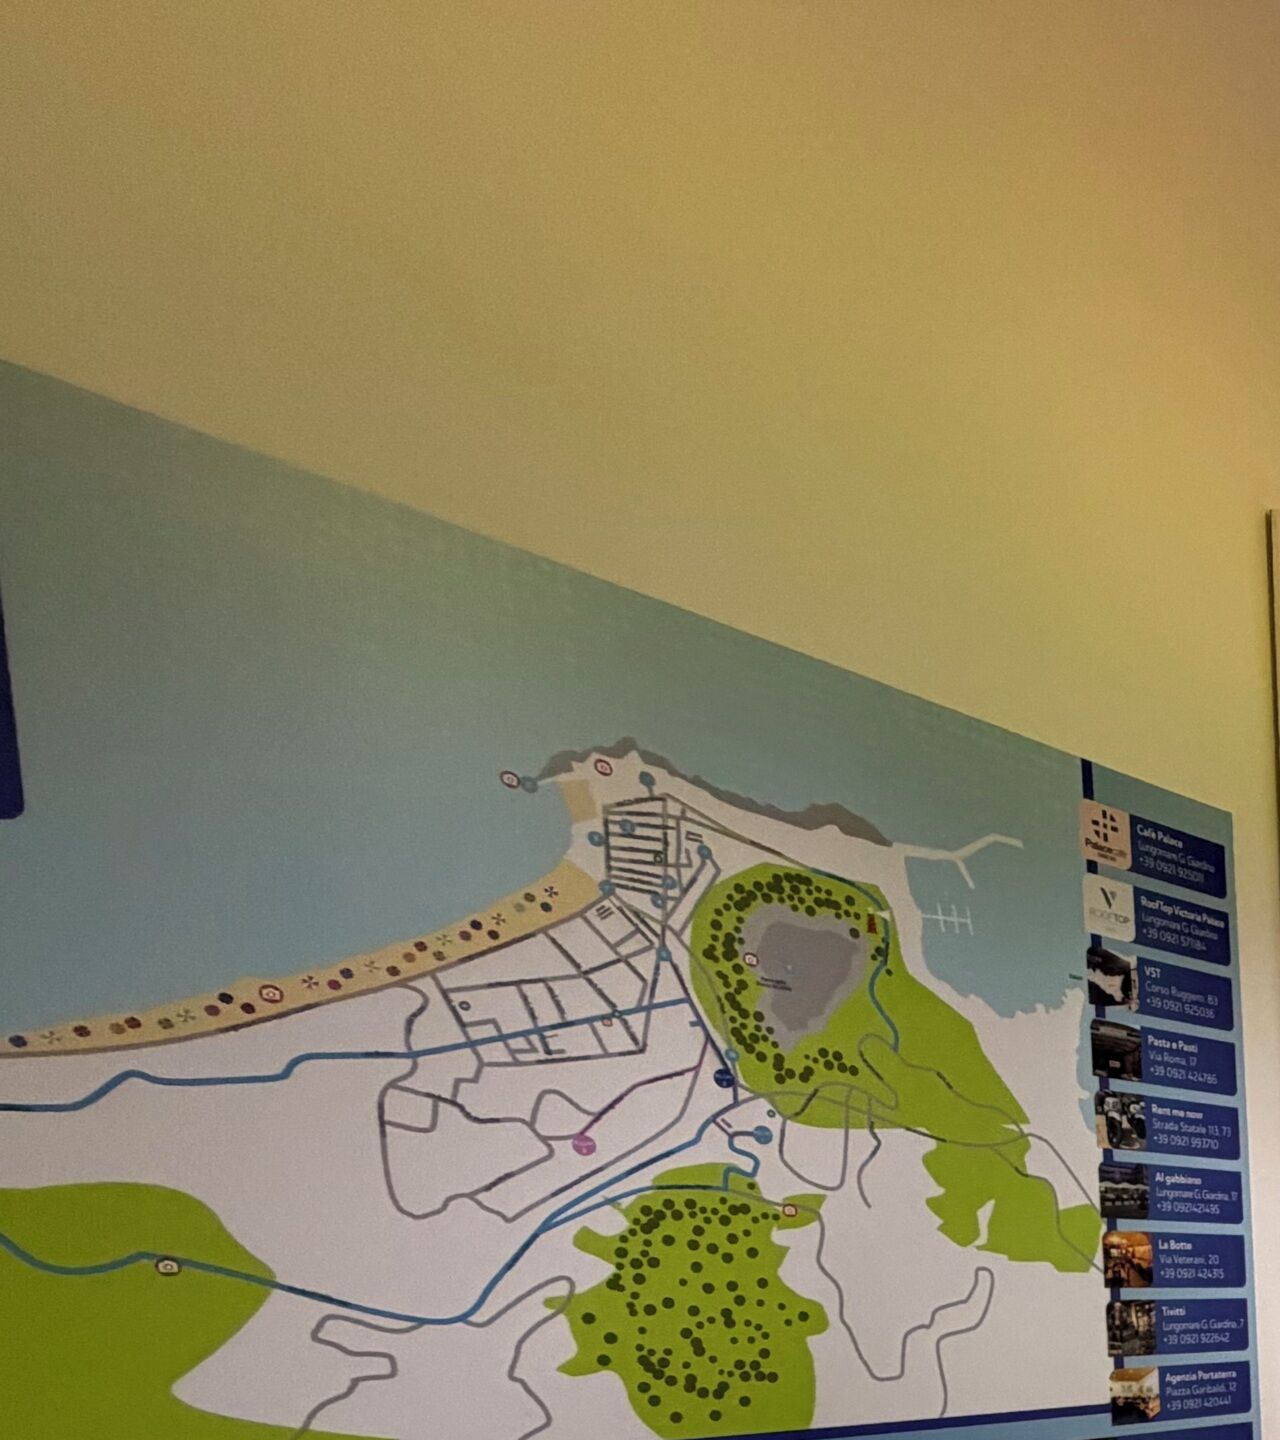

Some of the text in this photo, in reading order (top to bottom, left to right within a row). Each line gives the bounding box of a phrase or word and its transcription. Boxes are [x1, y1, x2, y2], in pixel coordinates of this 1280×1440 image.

[1158, 831, 1183, 848] Palace
[1139, 856, 1154, 868] +39
[1156, 860, 1176, 875] 0921
[1174, 905, 1201, 921] Victoria
[1201, 913, 1224, 928] Palace
[1143, 928, 1157, 939] +39
[1160, 931, 1179, 944] 0921
[1144, 965, 1161, 978] VST
[1146, 981, 1169, 995] Corso
[1146, 998, 1161, 1008] +39
[1163, 1001, 1182, 1012] 0921
[1148, 1035, 1170, 1049] Pasta
[1179, 1040, 1198, 1053] Pasti
[1149, 1051, 1162, 1062] Via
[1150, 1066, 1165, 1076] +39
[1167, 1067, 1186, 1079] 0921
[1152, 1104, 1203, 1119] Rent me now
[1153, 1118, 1179, 1131] Strada
[1181, 1120, 1206, 1134] Statale
[1153, 1134, 1168, 1144] +39
[1170, 1135, 1189, 1146] 0921
[1155, 1172, 1201, 1186] Al gabbiano
[1156, 1188, 1193, 1201] Lungomare
[1157, 1202, 1171, 1211] +39
[1159, 1240, 1192, 1250] La Botte
[1159, 1255, 1172, 1263] Via
[1208, 1255, 1219, 1264] 20
[1160, 1268, 1174, 1278] +39
[1176, 1268, 1195, 1278] 0921
[1162, 1306, 1186, 1316] Tivitti
[1163, 1321, 1200, 1333] Lungomare
[1163, 1335, 1178, 1345] +39
[1180, 1334, 1199, 1344] 0921
[1166, 1370, 1237, 1384] Agenzia Portaterra
[1166, 1387, 1190, 1396] Piazza
[1167, 1400, 1181, 1410] +39
[1183, 1399, 1201, 1410] 0921
